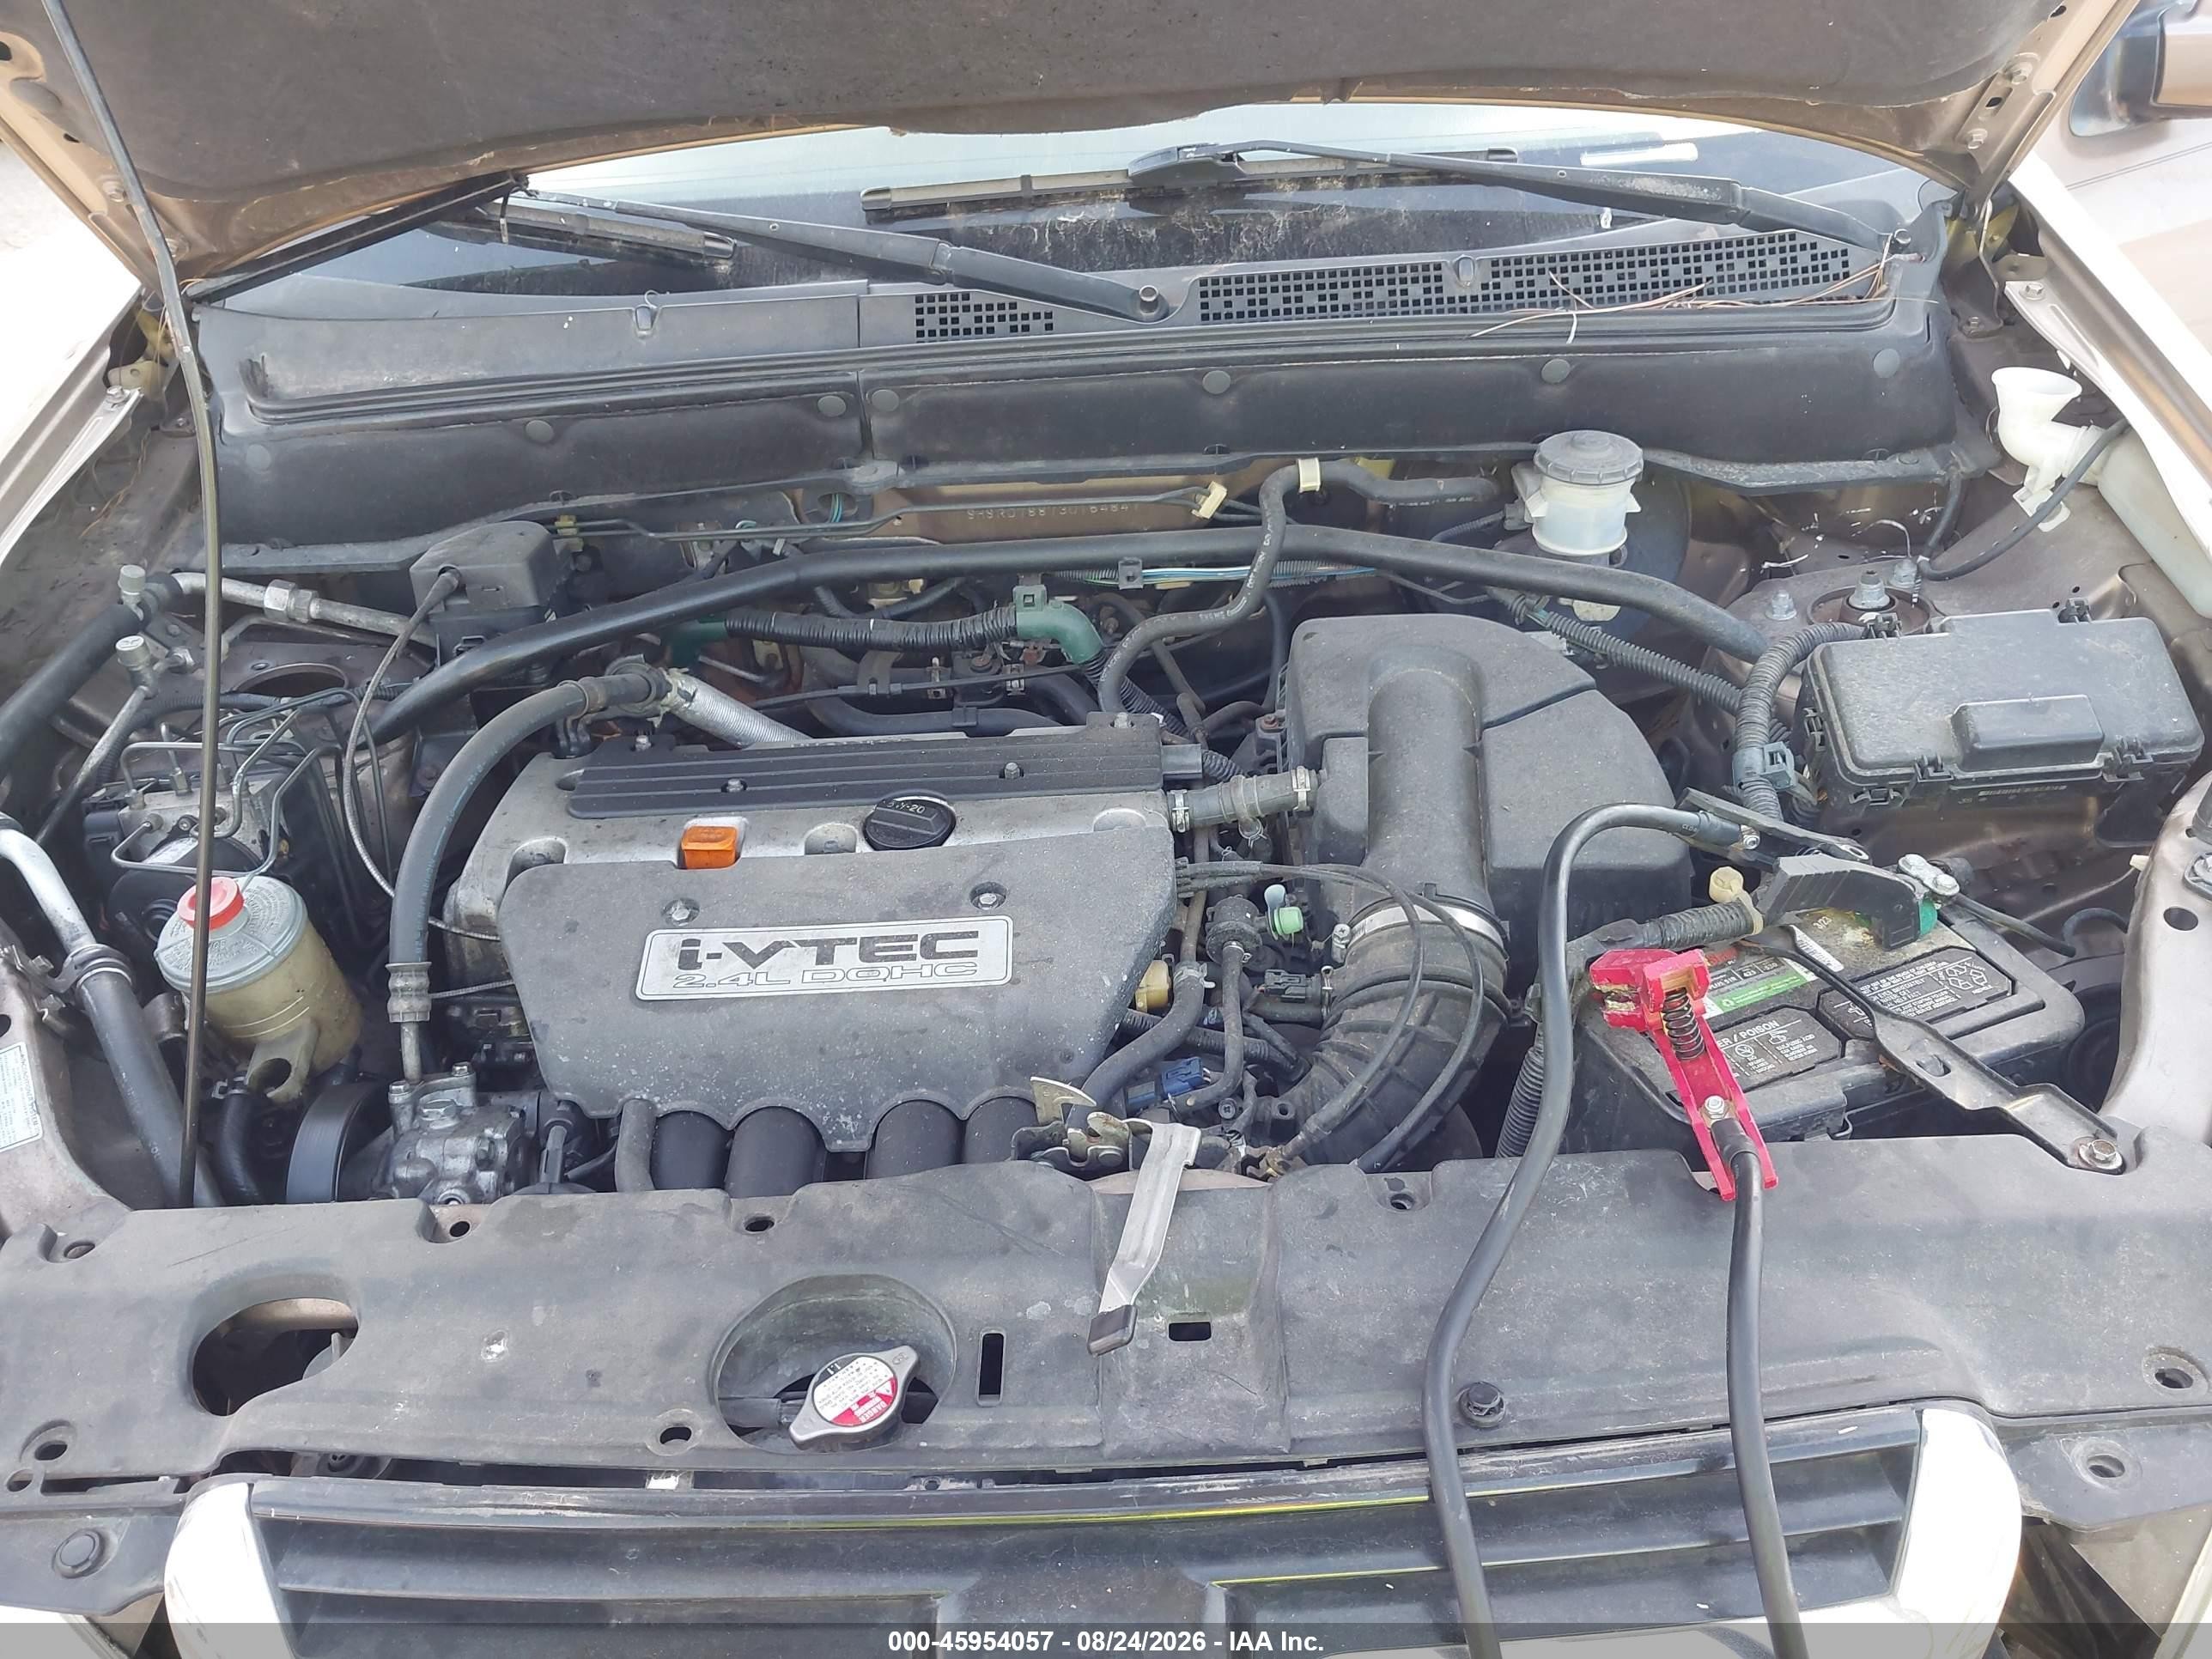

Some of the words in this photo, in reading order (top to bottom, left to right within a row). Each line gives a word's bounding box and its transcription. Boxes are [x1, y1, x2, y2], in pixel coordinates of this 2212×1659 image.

[1813, 916, 1832, 929] 3/23
[677, 930, 979, 971] i-VTEC
[673, 971, 790, 989] 2.4L
[801, 962, 978, 984] DOHC
[1739, 1020, 1780, 1039] POISON
[827, 1363, 841, 1375] 1.1
[860, 1400, 886, 1422] DANGER
